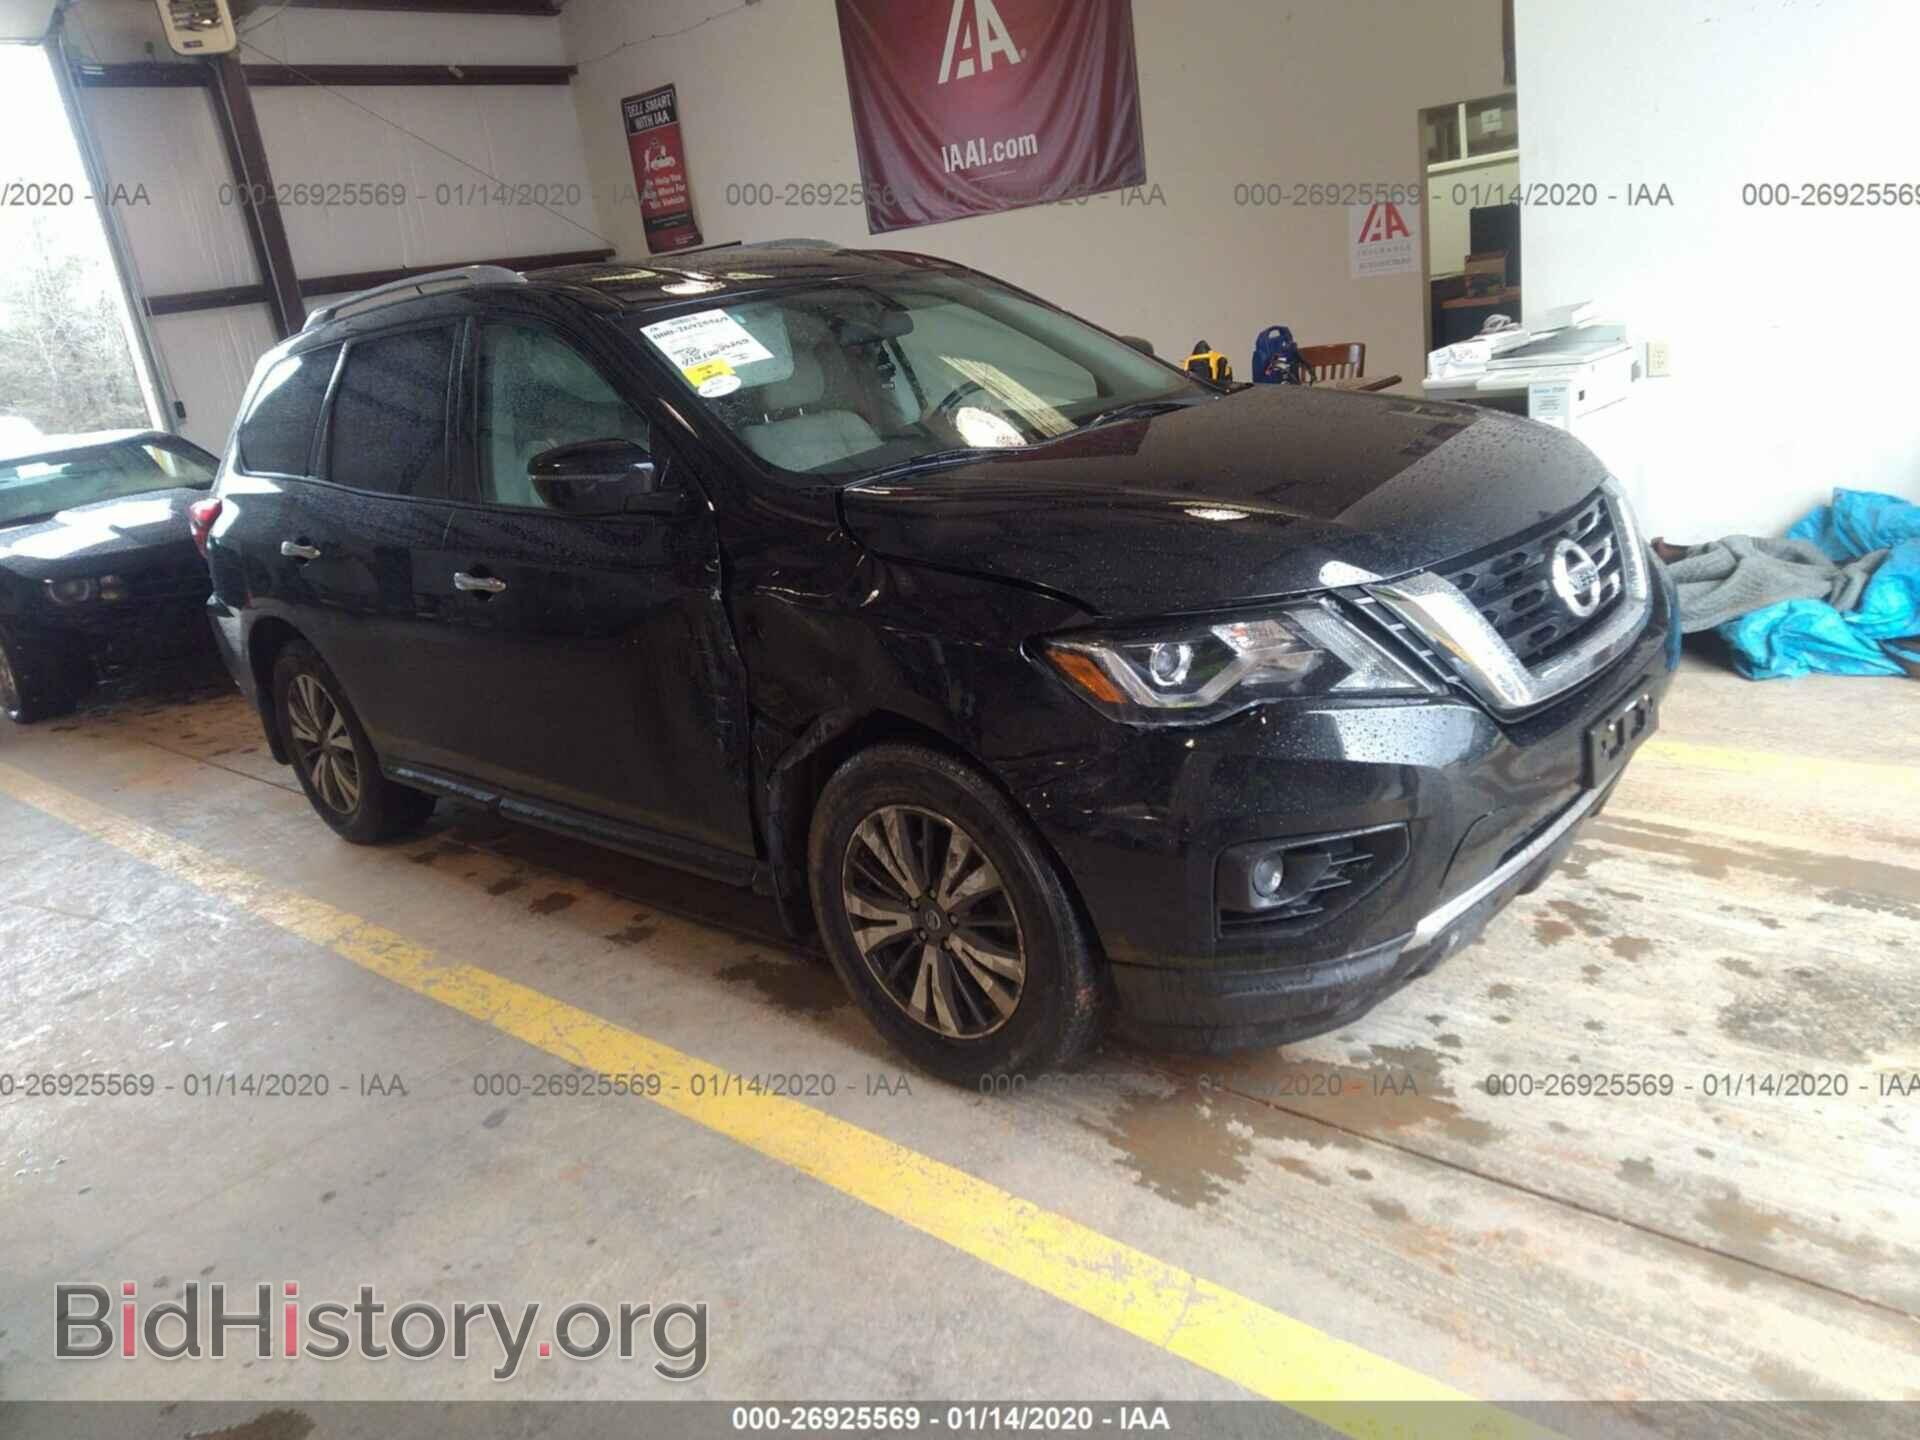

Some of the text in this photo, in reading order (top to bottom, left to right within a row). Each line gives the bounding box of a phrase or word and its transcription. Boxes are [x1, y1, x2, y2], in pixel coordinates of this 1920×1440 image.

[644, 94, 672, 113] SMART
[635, 109, 670, 130] WITH IAA
[941, 133, 1038, 174] IAAI.com
